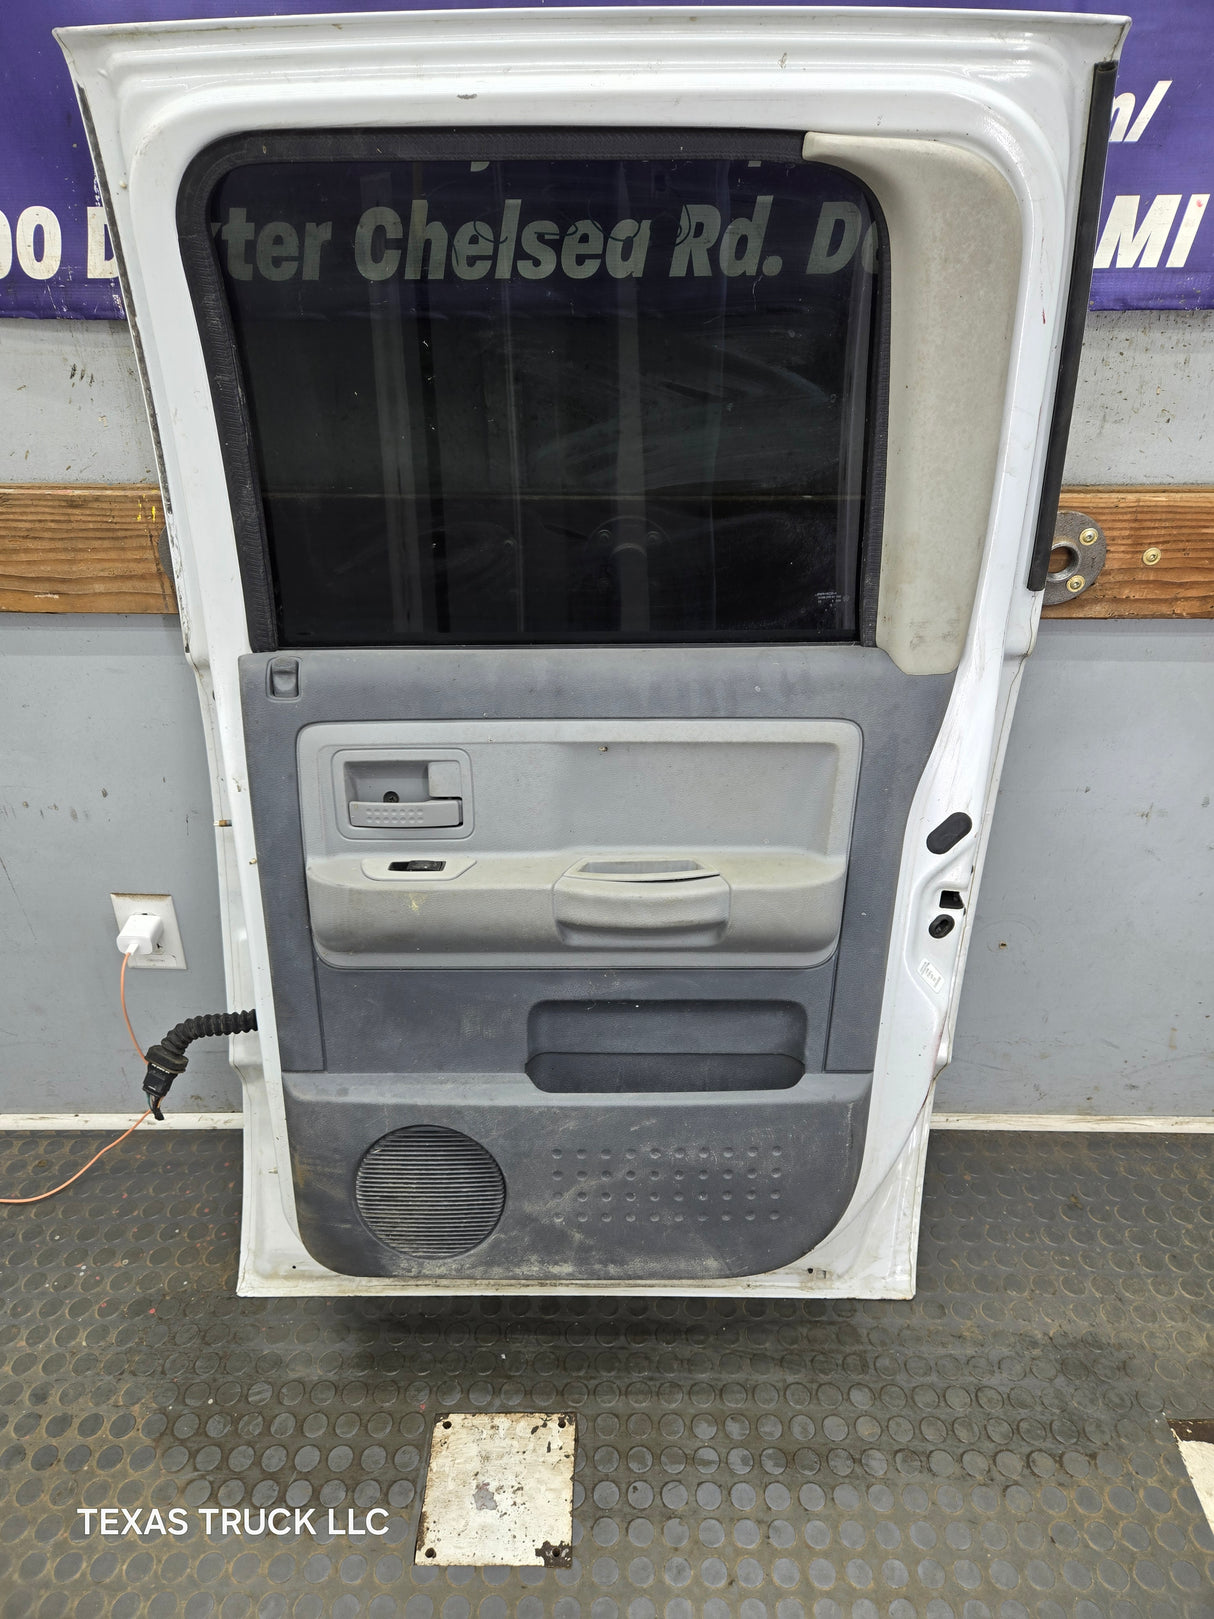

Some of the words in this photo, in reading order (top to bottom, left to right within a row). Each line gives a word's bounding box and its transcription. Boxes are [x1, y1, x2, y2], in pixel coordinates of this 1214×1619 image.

[354, 199, 651, 281] Chelsea
[669, 195, 783, 278] Rd.
[1092, 193, 1211, 268] MI
